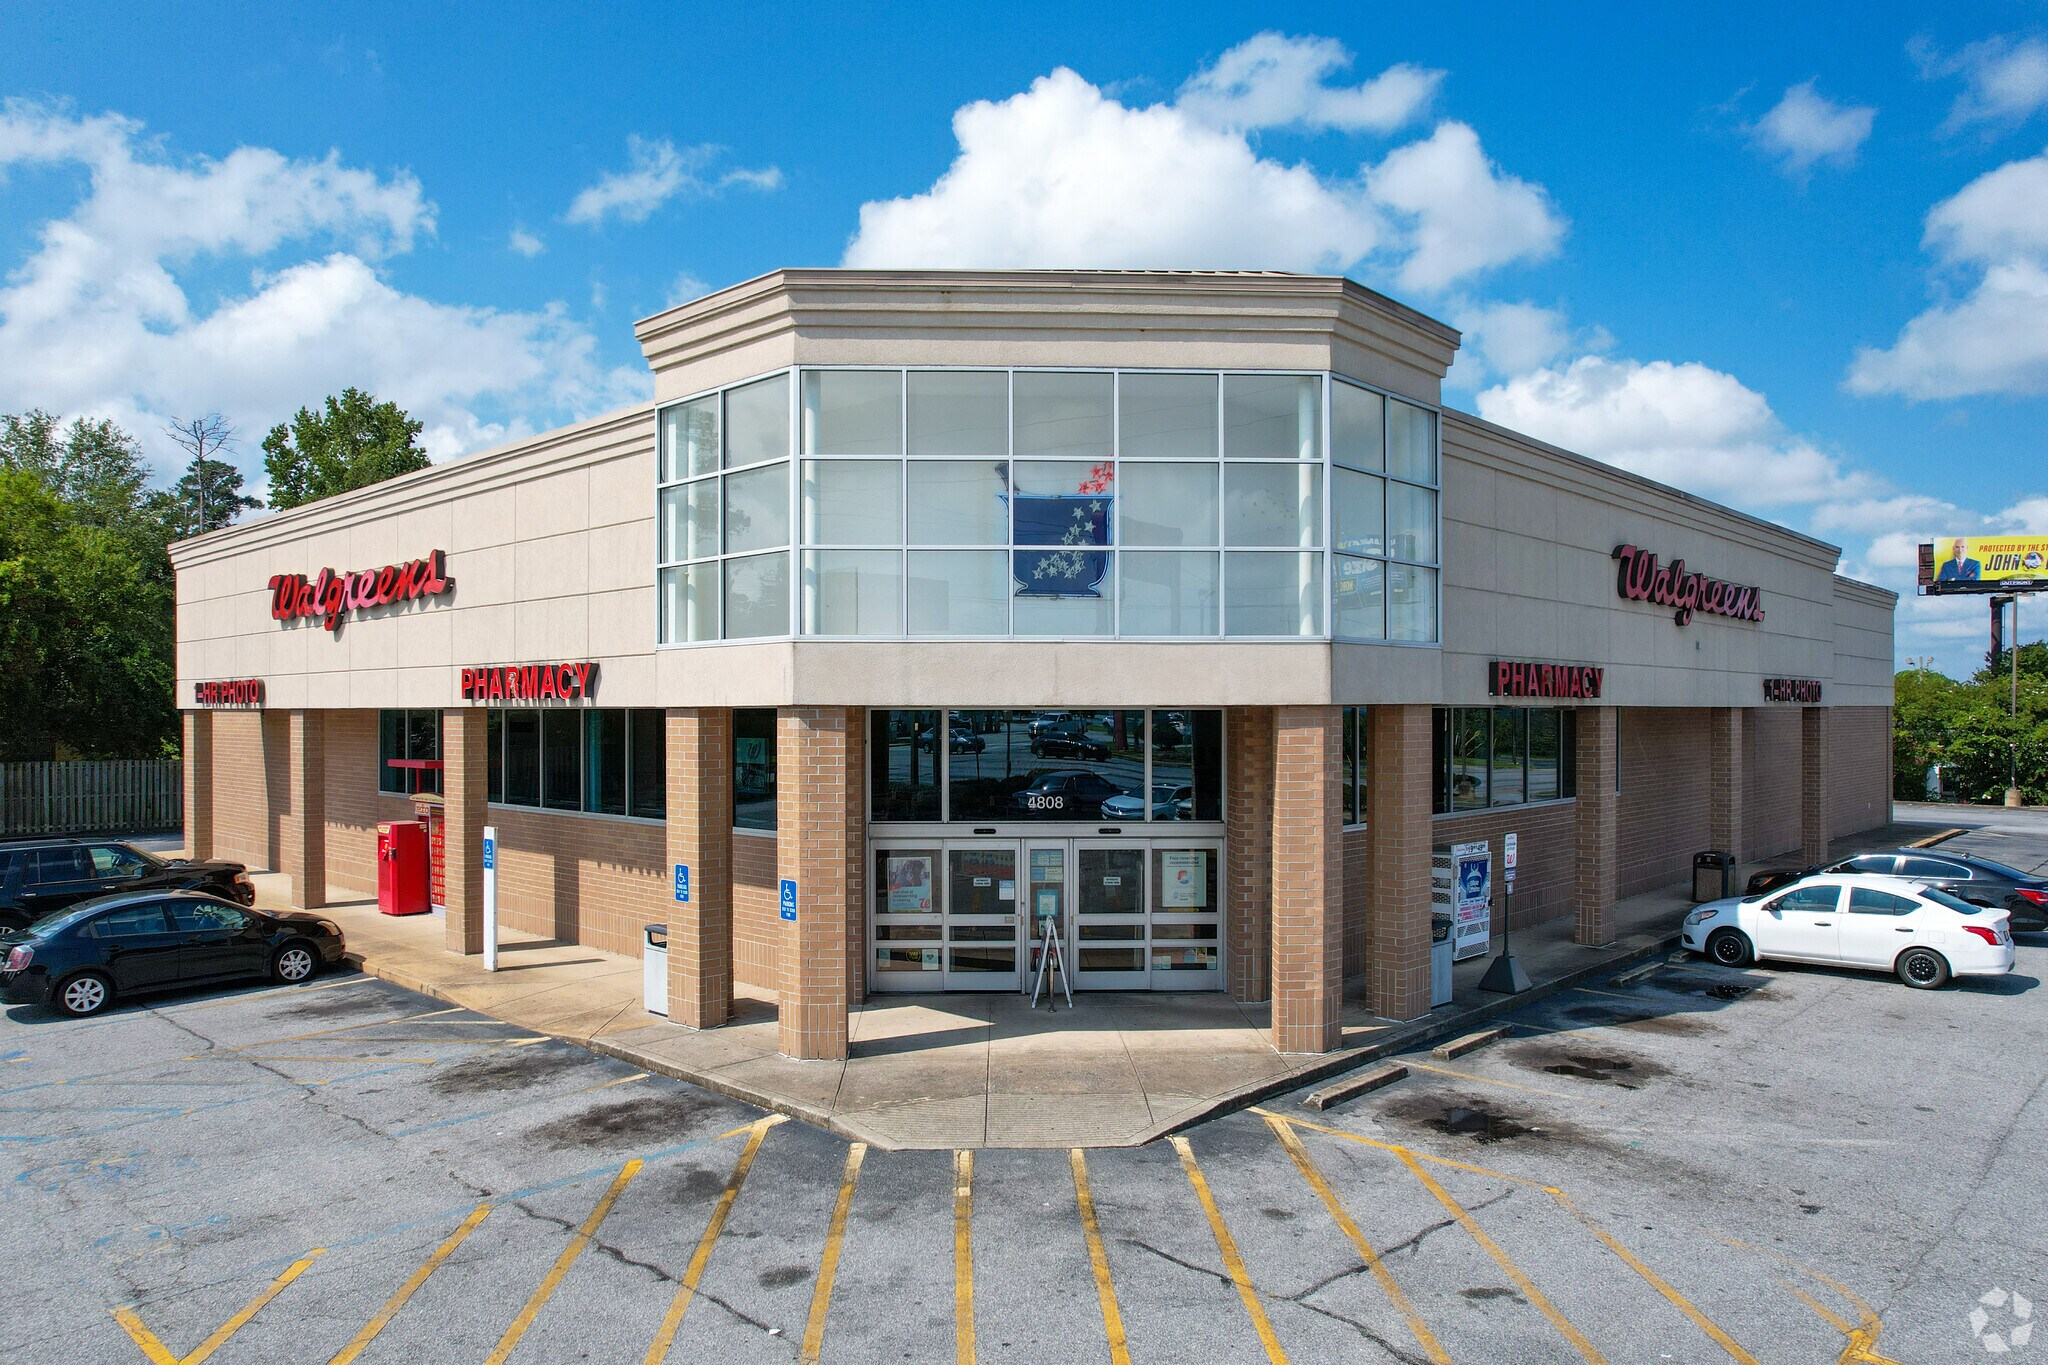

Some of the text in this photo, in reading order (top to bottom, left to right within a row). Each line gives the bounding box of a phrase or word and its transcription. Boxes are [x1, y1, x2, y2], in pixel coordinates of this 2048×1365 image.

[1979, 545, 2015, 553] PROTECTED
[1985, 554, 2021, 571] JOHN
[268, 548, 455, 632] Walgreens
[1611, 544, 1765, 626] Walgreens
[221, 679, 263, 703] PHOTO
[461, 663, 598, 700] PHARMACY
[1490, 661, 1604, 698] PHARMACY
[1795, 680, 1822, 702] PHOTO
[1028, 796, 1064, 809] 4808
